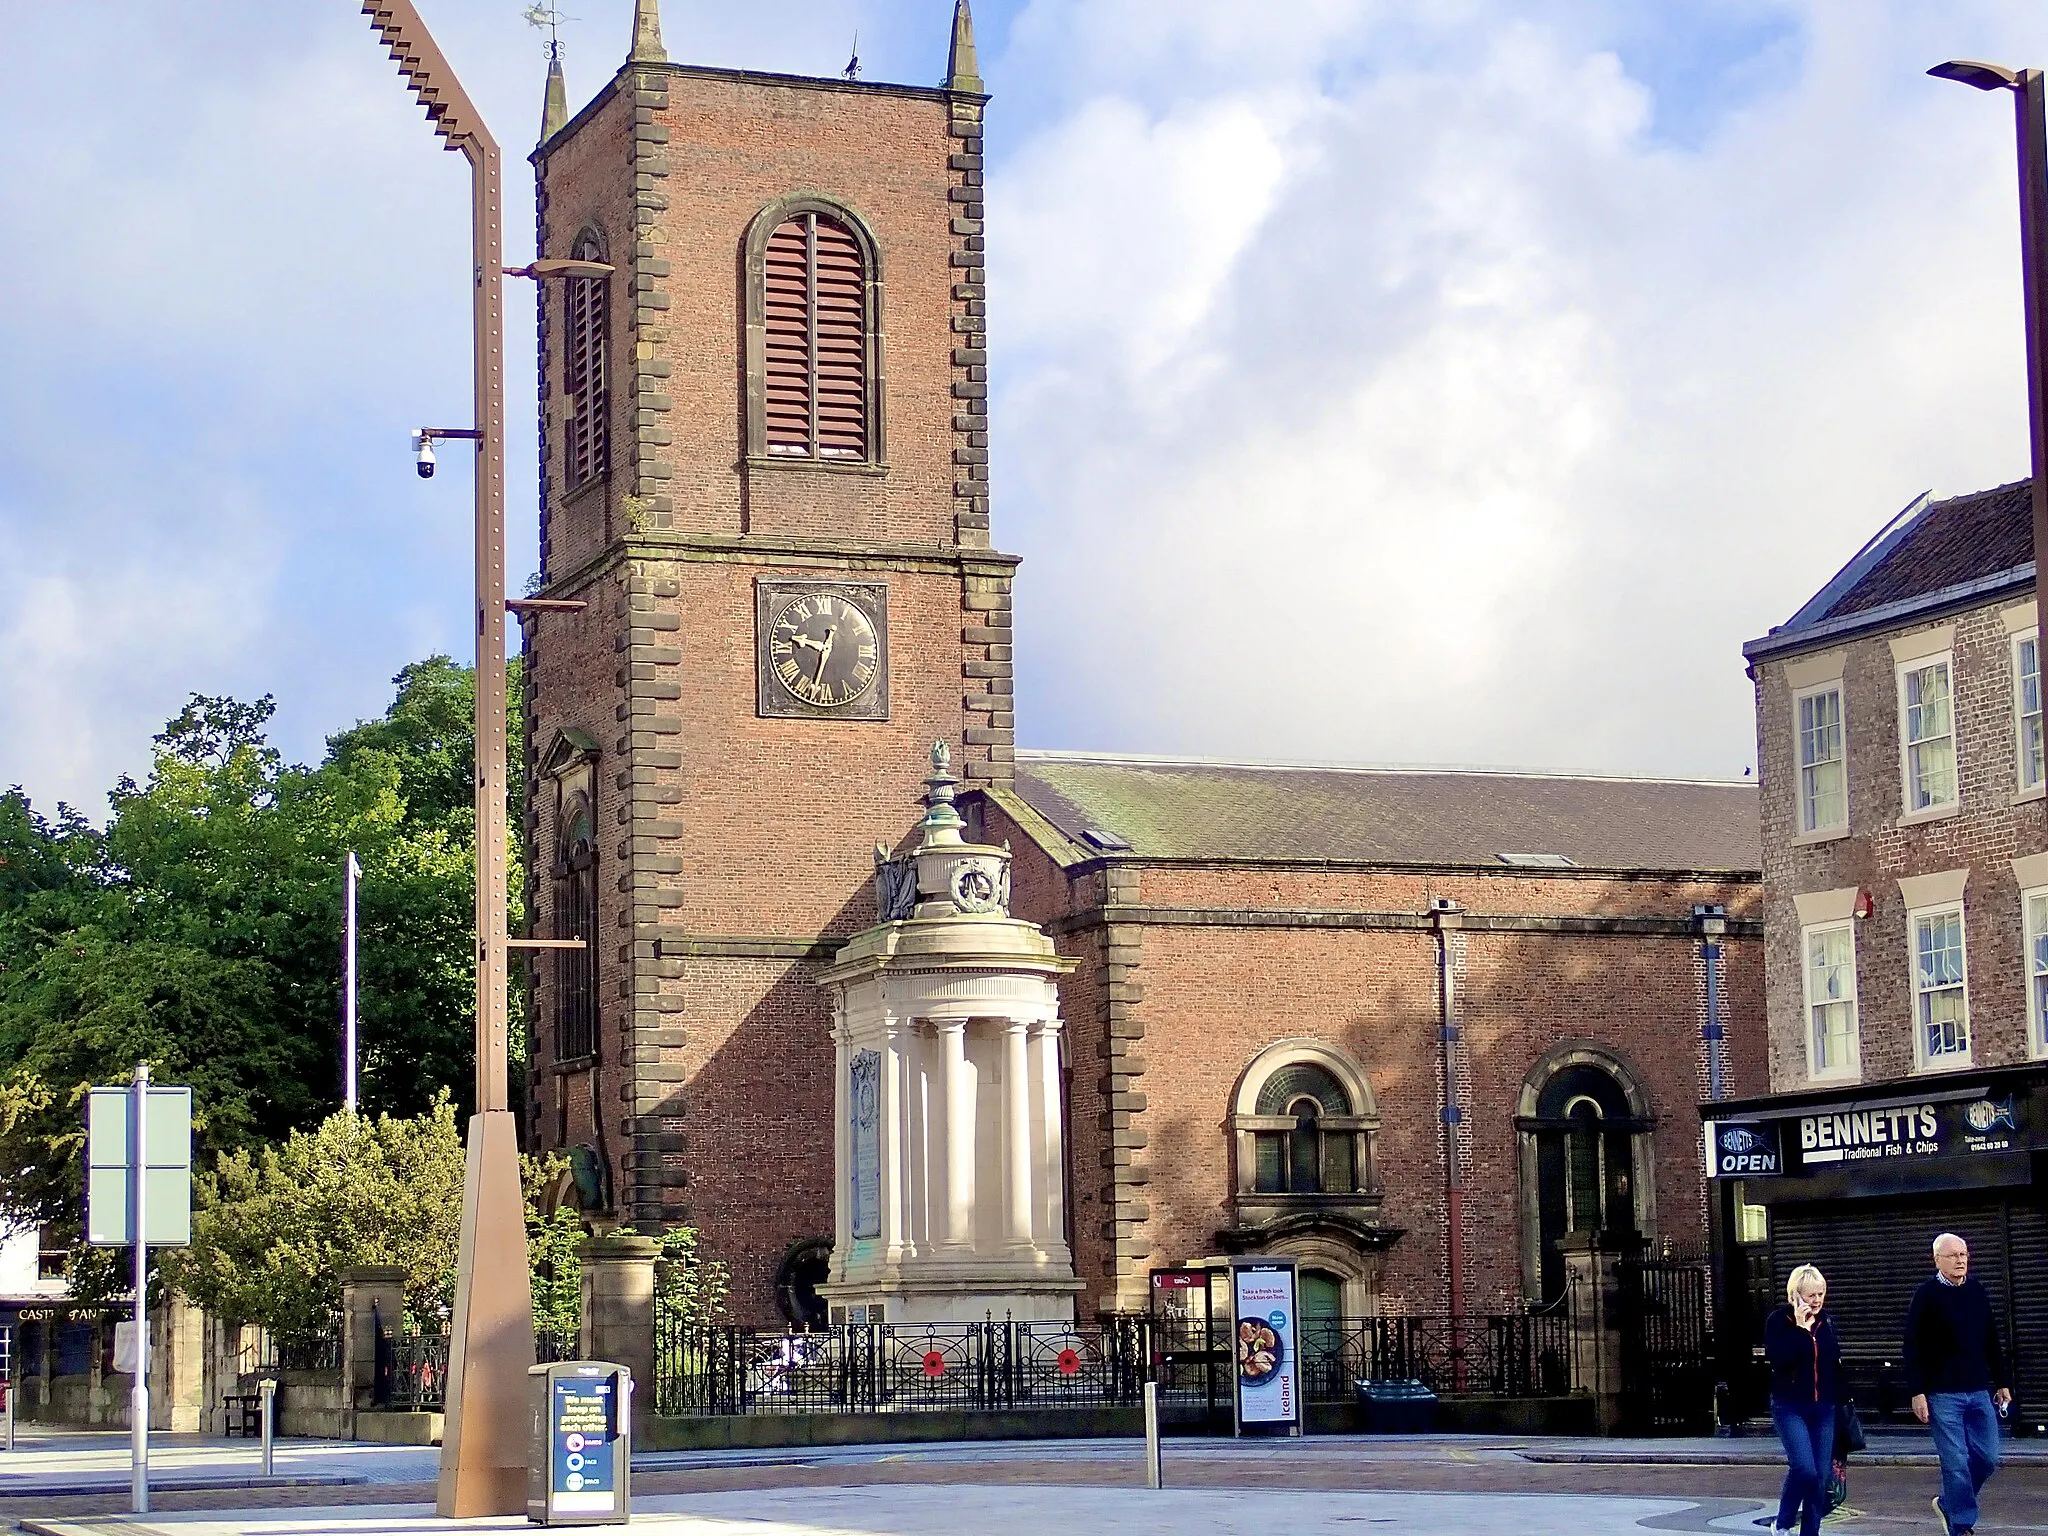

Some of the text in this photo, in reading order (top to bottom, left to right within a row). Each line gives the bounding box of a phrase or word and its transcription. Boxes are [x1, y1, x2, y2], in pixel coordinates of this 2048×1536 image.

[1968, 1100, 1995, 1129] BENNETTS
[1800, 1105, 1938, 1150] BENNETTS
[1723, 1130, 1753, 1152] BENNETTS
[1844, 1140, 1939, 1161] Traditional Fish & Chips
[1722, 1154, 1776, 1172] OPEN
[1280, 1375, 1291, 1416] Iceland
[561, 1415, 606, 1424] protecting
[567, 1405, 588, 1414] keep
[560, 1423, 607, 1431] each other.
